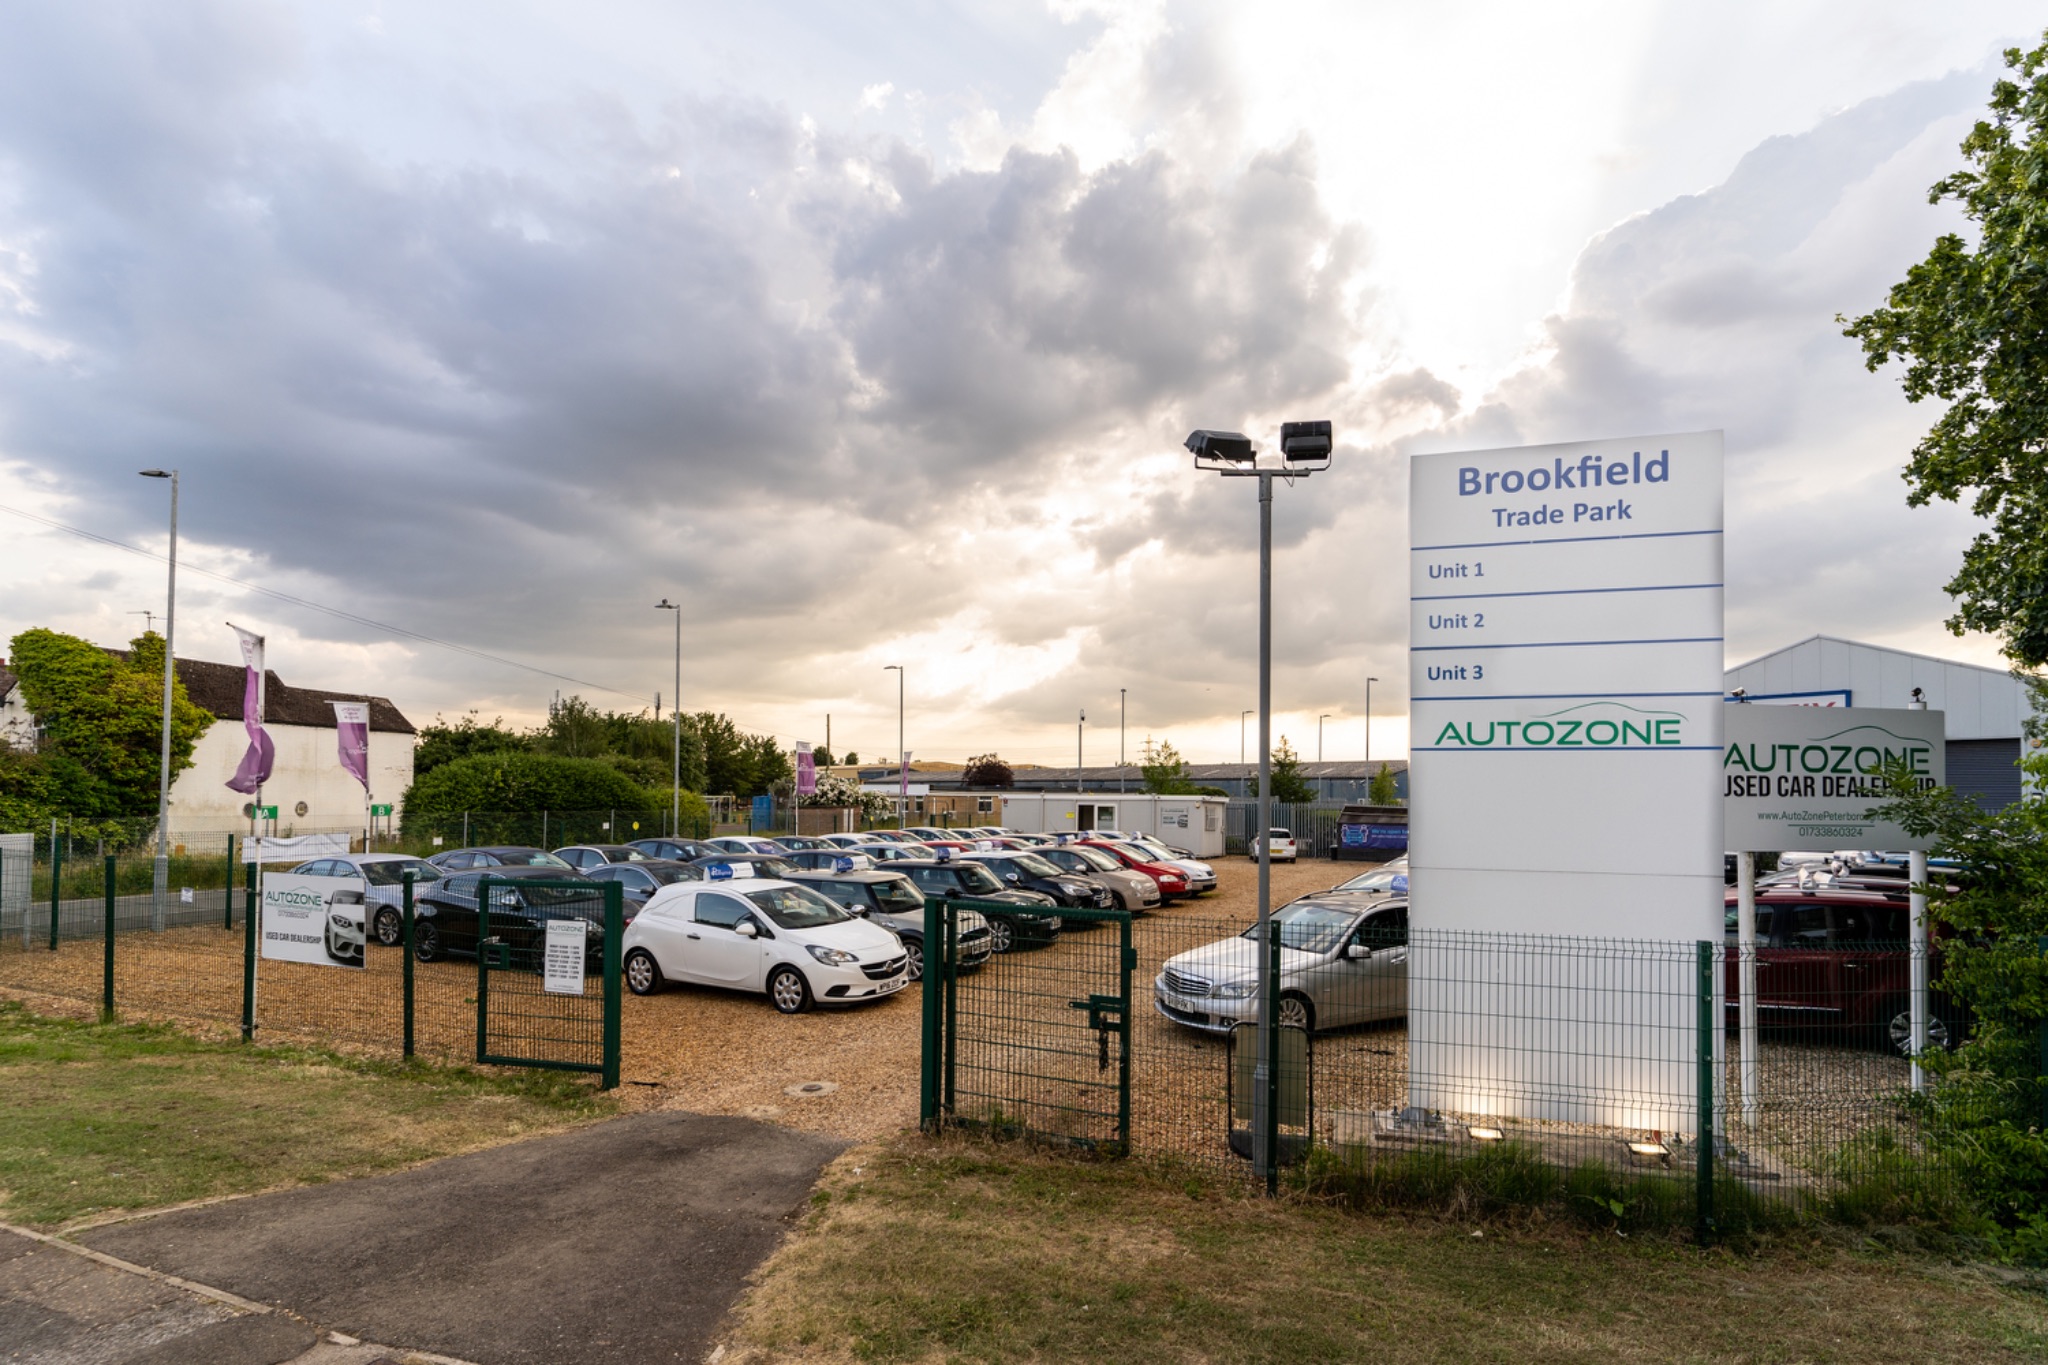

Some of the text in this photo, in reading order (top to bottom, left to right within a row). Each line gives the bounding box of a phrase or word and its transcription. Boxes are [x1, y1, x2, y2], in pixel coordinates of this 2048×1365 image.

[1458, 449, 1670, 497] Brookfield
[1491, 499, 1633, 528] Trade Park
[1428, 562, 1484, 579] Unit 1
[1428, 613, 1485, 630] Unit 2
[1427, 665, 1484, 681] Unit 3
[1434, 719, 1682, 746] AUTOZONE
[1724, 742, 1930, 775] AUTOZONE
[1777, 775, 1816, 798] CAR
[1799, 826, 1863, 838] 01733860324
[265, 890, 322, 907] AUTOZONE
[549, 924, 584, 933] AUTOZONE
[265, 931, 322, 944] USED CAR DEALERSHIP
